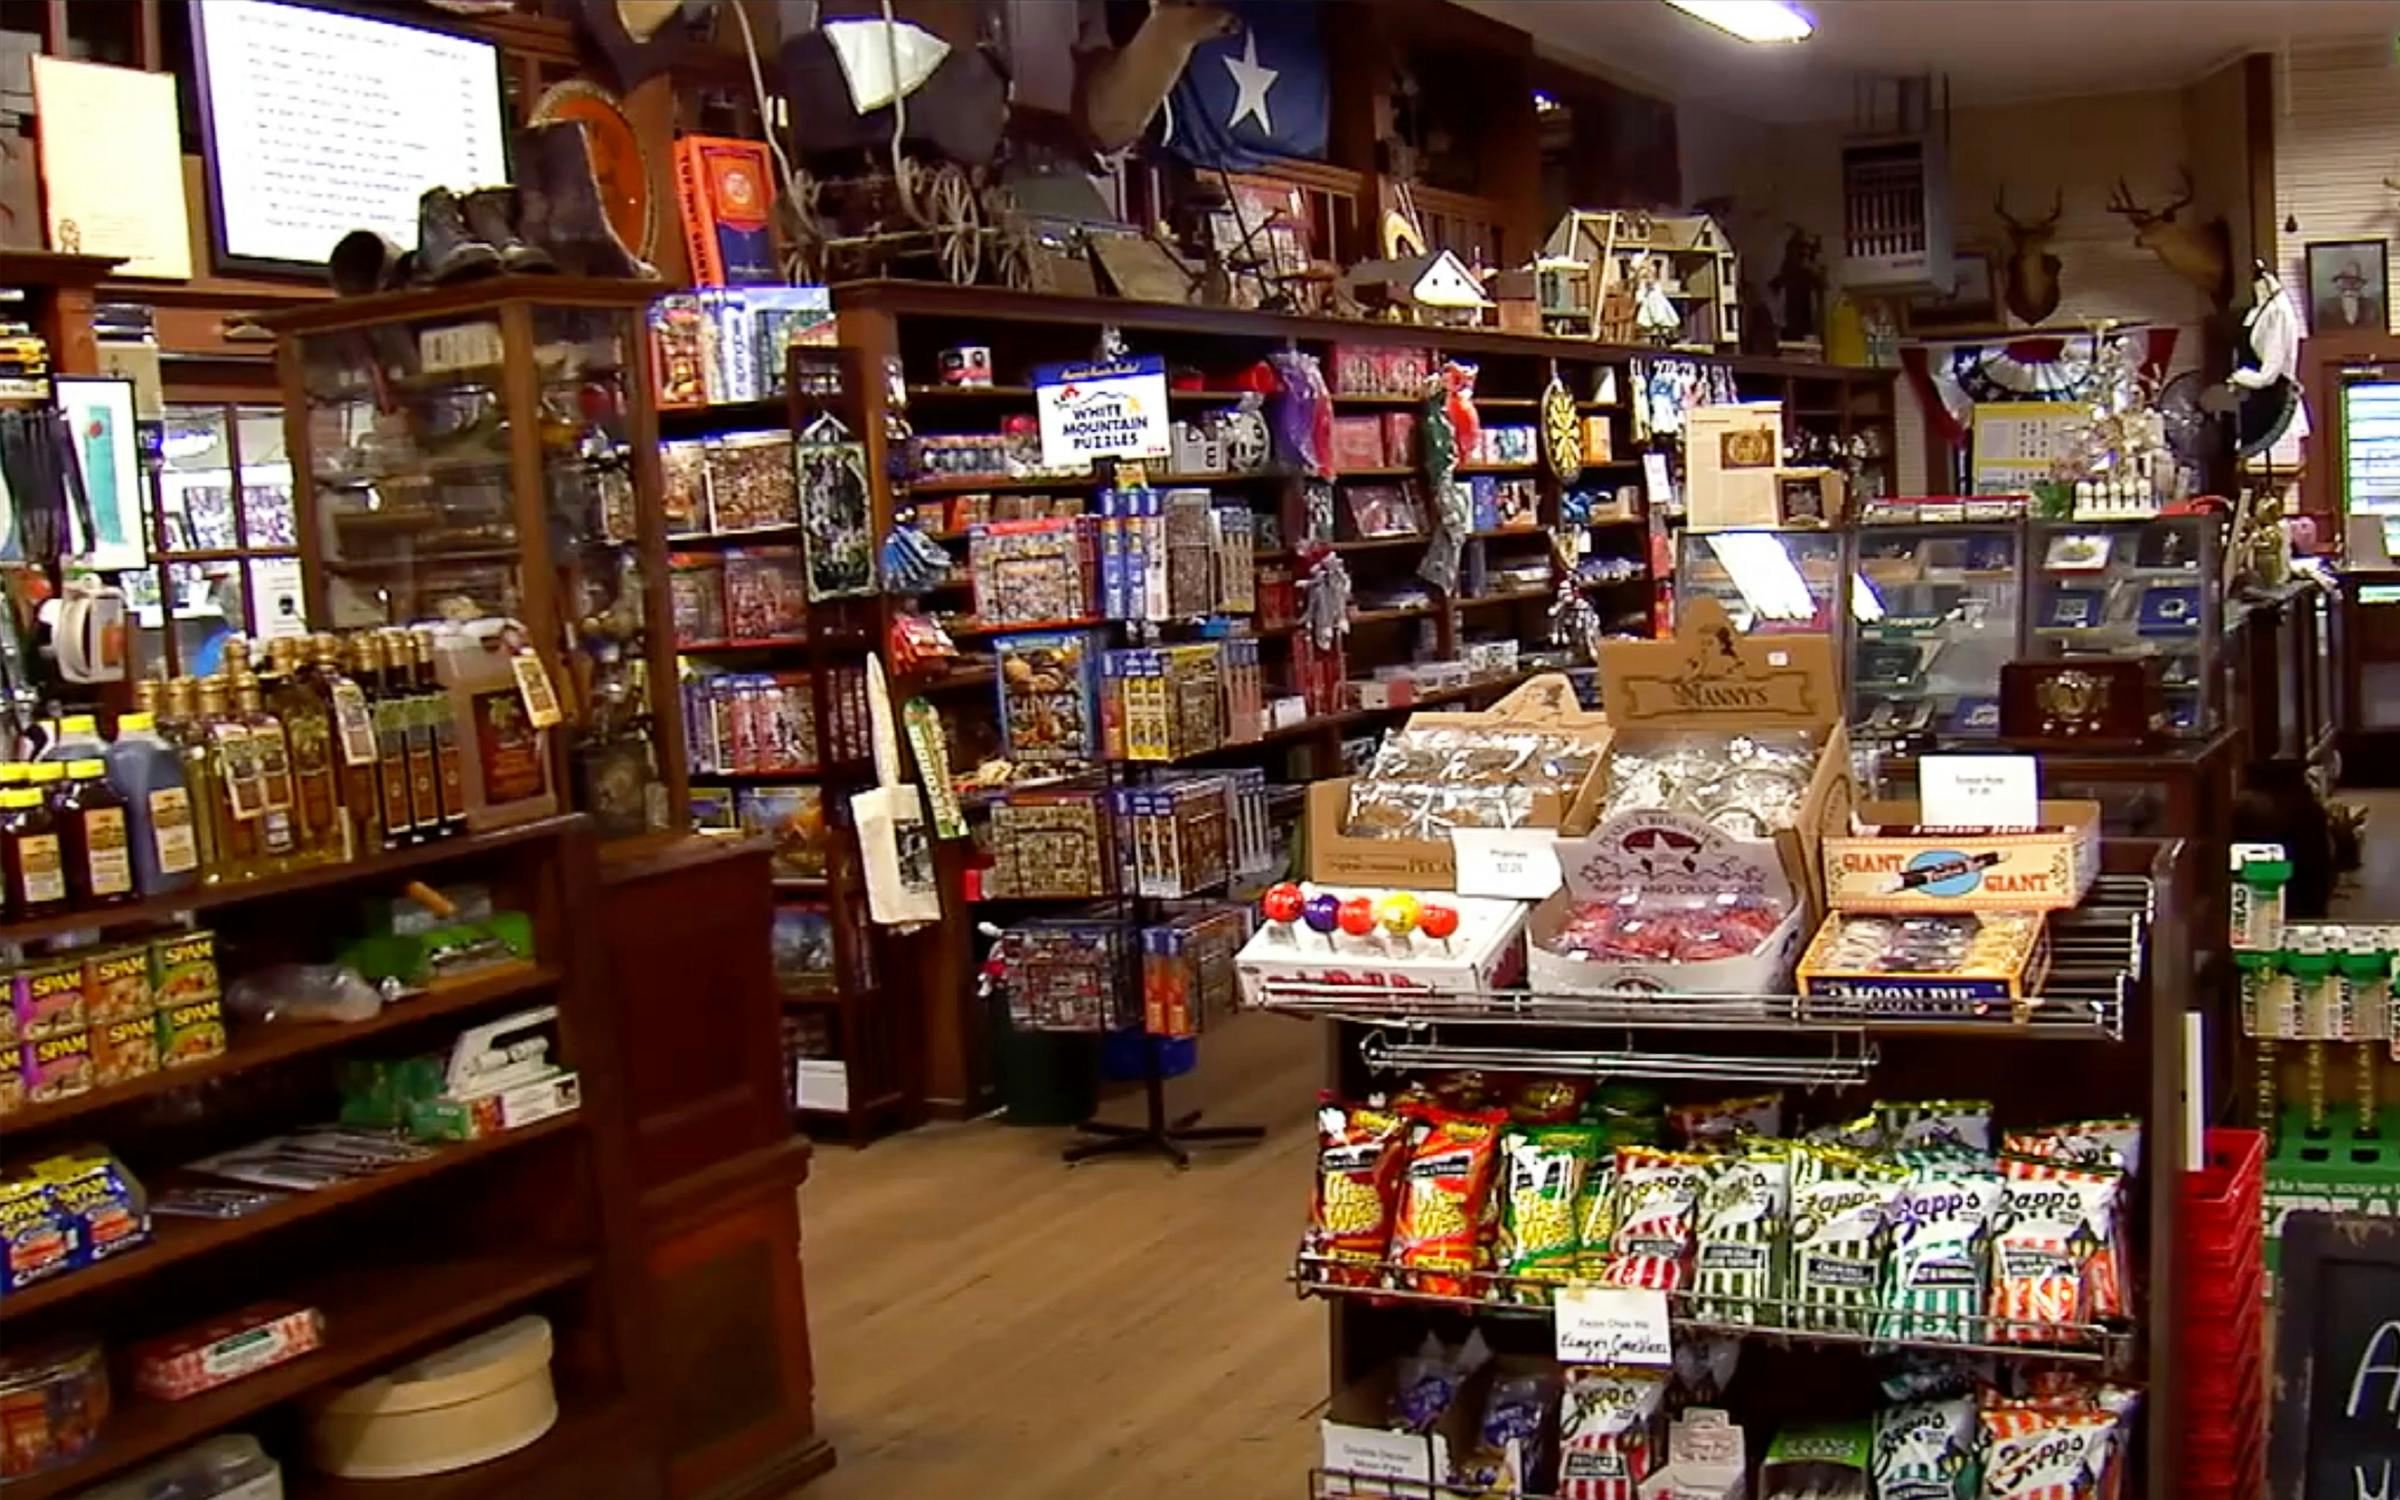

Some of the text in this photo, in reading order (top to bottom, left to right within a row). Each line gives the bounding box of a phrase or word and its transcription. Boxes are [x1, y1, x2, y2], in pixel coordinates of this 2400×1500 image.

[1072, 403, 1122, 421] WHITE
[1062, 416, 1148, 437] MOUNTAIN
[1073, 432, 1139, 450] PUZZLES
[1842, 853, 1905, 873] GIANT
[1984, 873, 2050, 893] GIANT
[165, 940, 213, 962] SPAM
[98, 956, 148, 979] SPAM
[32, 970, 82, 997] SPAM
[173, 1001, 221, 1026] SPAM
[108, 1015, 157, 1042] SPAM
[38, 1034, 89, 1062] SPAM
